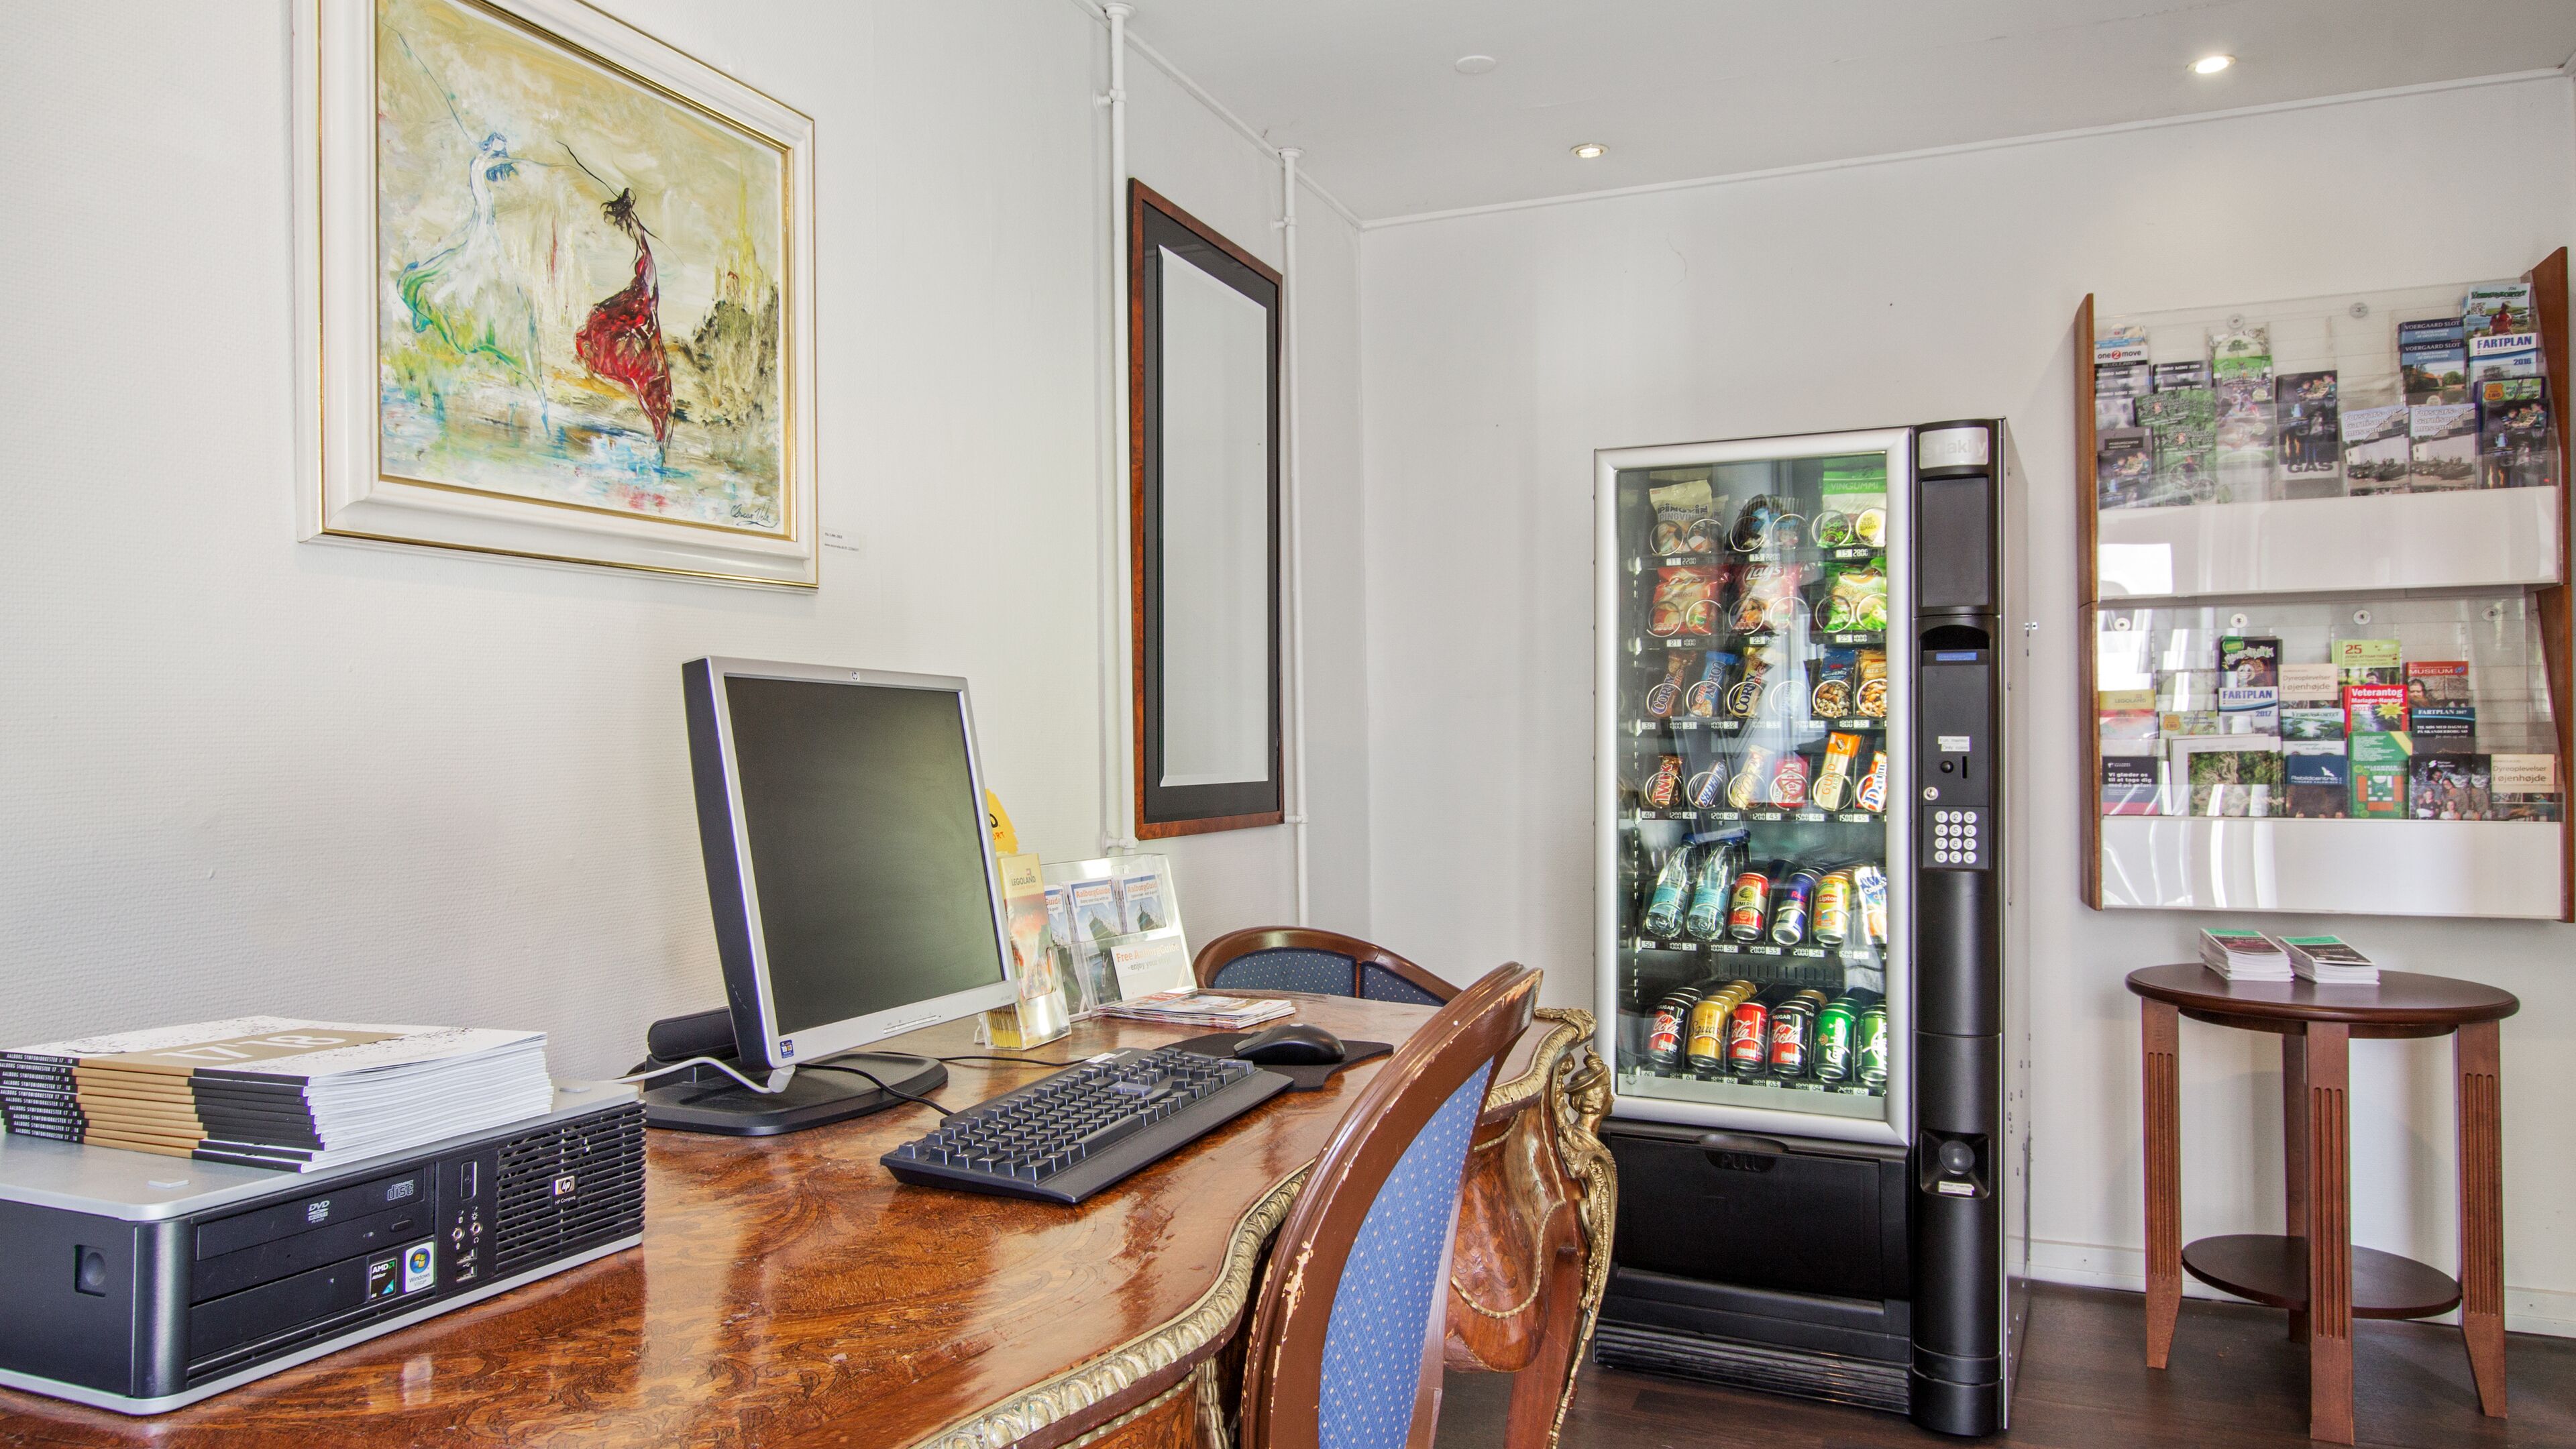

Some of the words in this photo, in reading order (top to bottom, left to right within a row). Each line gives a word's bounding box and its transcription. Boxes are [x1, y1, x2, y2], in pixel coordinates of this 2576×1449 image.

[2405, 322, 2443, 330] VOERGAARD
[2405, 344, 2443, 352] VOERGAARD
[2477, 335, 2532, 350] FARTPLAN
[2287, 462, 2334, 474] GAS
[1831, 482, 1879, 490] VINGUMMI
[1658, 503, 1708, 514] PINGVIN
[2345, 644, 2362, 655] 25
[1754, 665, 1766, 685] BIG
[1652, 673, 1675, 714] CORNY
[1734, 673, 1756, 714] CORNY
[2287, 683, 2331, 692] øjenhøjde
[2351, 688, 2404, 698] Veterantog
[1696, 685, 1707, 704] BIG
[2222, 690, 2273, 700] FARTPLAN
[2493, 765, 2547, 773] Dyreoplevelser
[1654, 763, 1674, 805] TWIX
[1821, 763, 1836, 796] GULD
[1864, 763, 1886, 805] Daim
[2498, 773, 2547, 784] øjenhøjde
[1011, 875, 1036, 886] LEGOLAND
[1075, 886, 1111, 898] AalborgGuide
[1116, 951, 1133, 963] Free
[1134, 941, 1181, 960] AalborgGuide
[1653, 1013, 1683, 1035] Cola
[1689, 1020, 1725, 1037] Squash
[1772, 1024, 1803, 1044] Cola
[387, 1183, 415, 1201] disc
[309, 1200, 330, 1212] DVD
[372, 1263, 388, 1274] AMD
[409, 1273, 430, 1283] Windows
